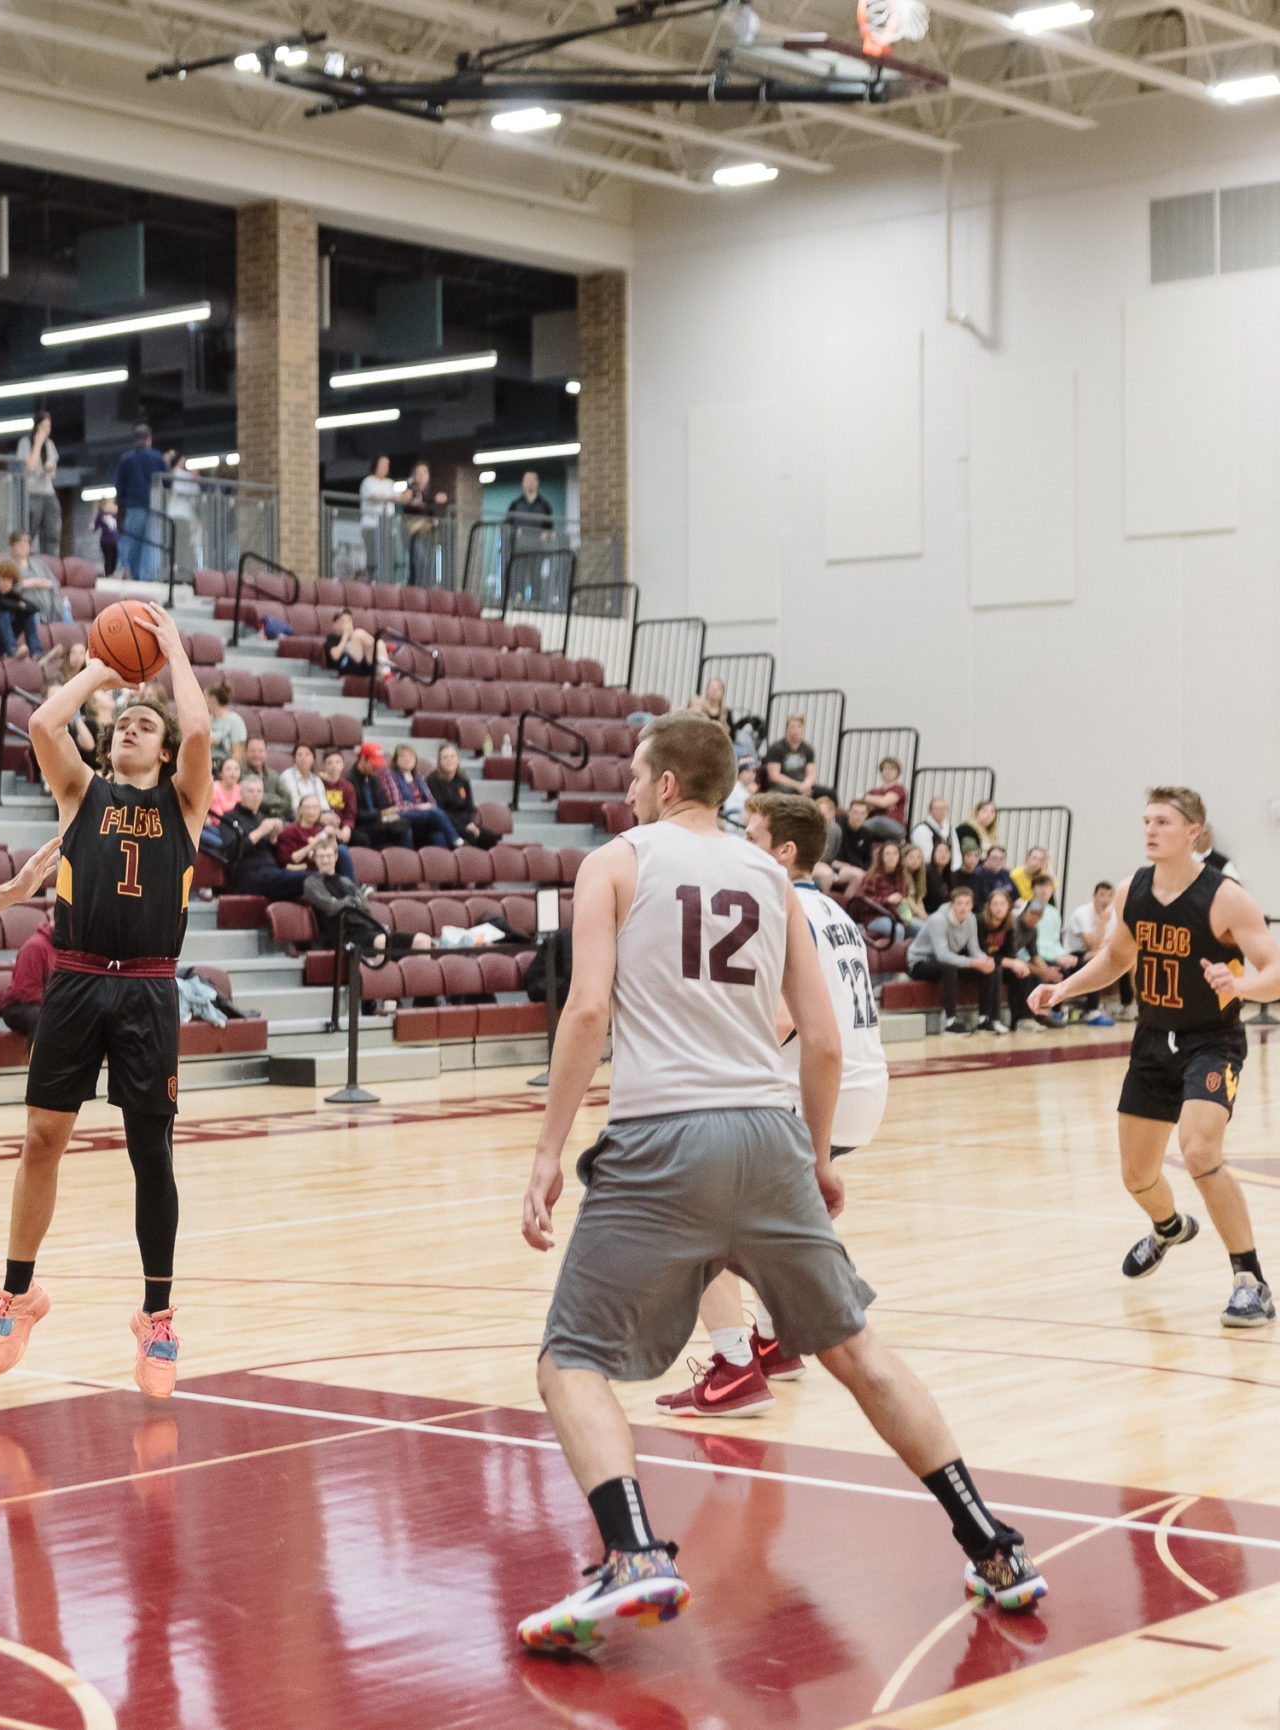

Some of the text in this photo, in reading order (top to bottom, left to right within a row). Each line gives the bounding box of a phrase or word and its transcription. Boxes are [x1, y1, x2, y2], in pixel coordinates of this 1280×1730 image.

[100, 806, 163, 838] FLBC
[117, 840, 142, 897] 1
[676, 885, 759, 986] 12
[1136, 920, 1191, 957] FLBC
[1141, 956, 1183, 1009] 11
